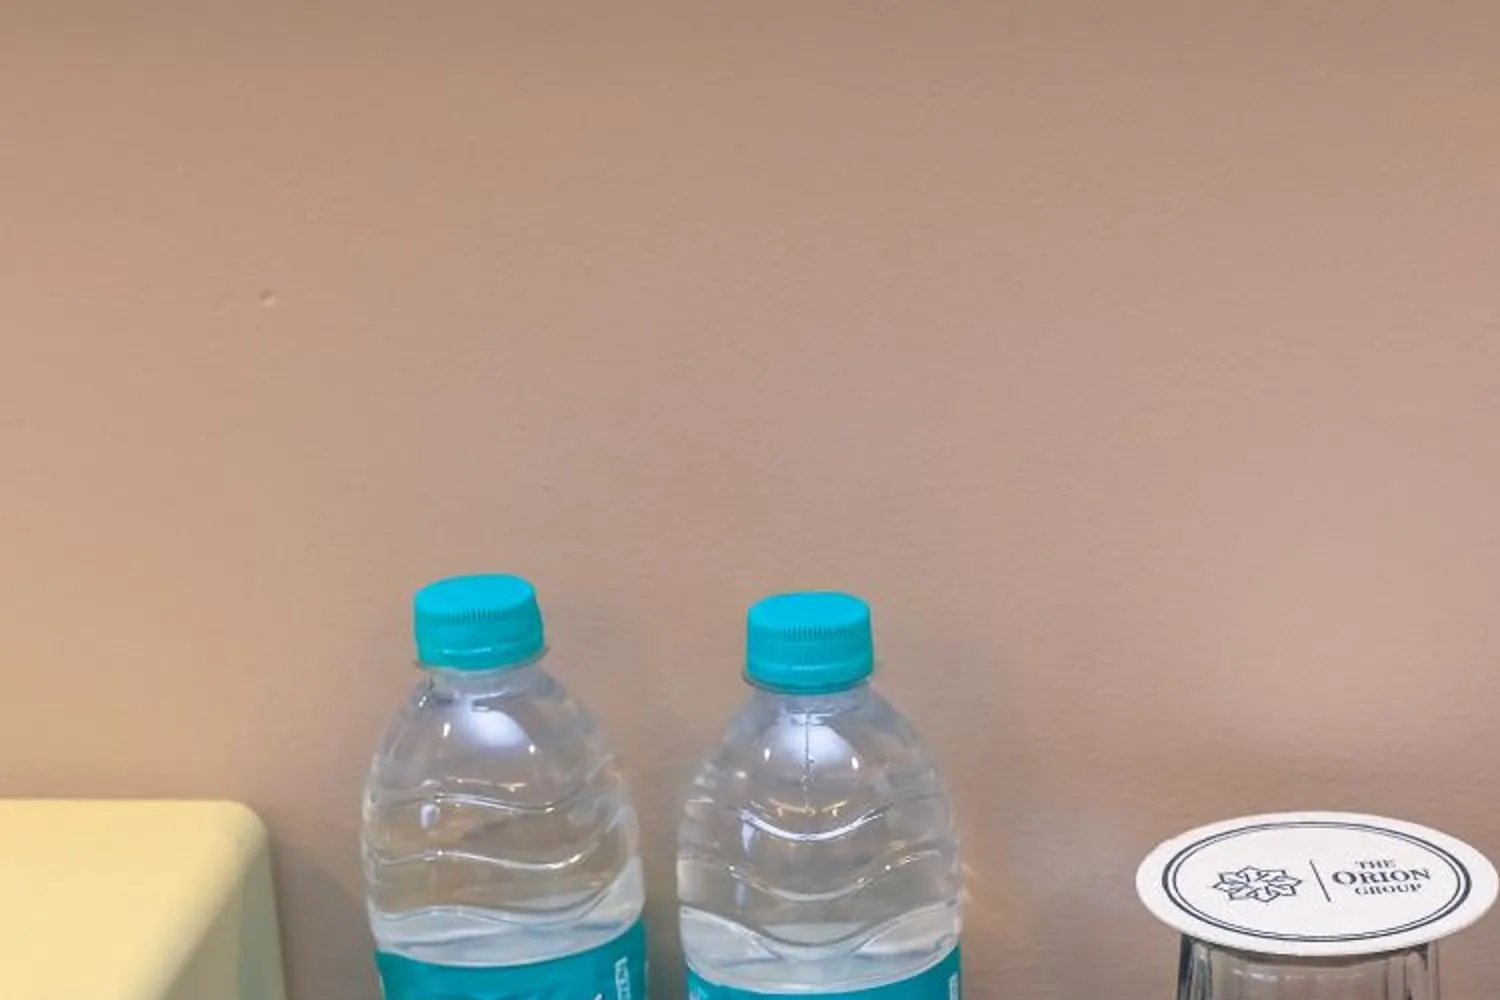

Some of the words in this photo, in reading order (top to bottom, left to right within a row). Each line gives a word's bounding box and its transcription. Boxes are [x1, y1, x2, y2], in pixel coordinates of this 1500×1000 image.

[1355, 859, 1396, 869] THE
[1332, 867, 1431, 885] ORION
[1355, 884, 1421, 895] GROUP
